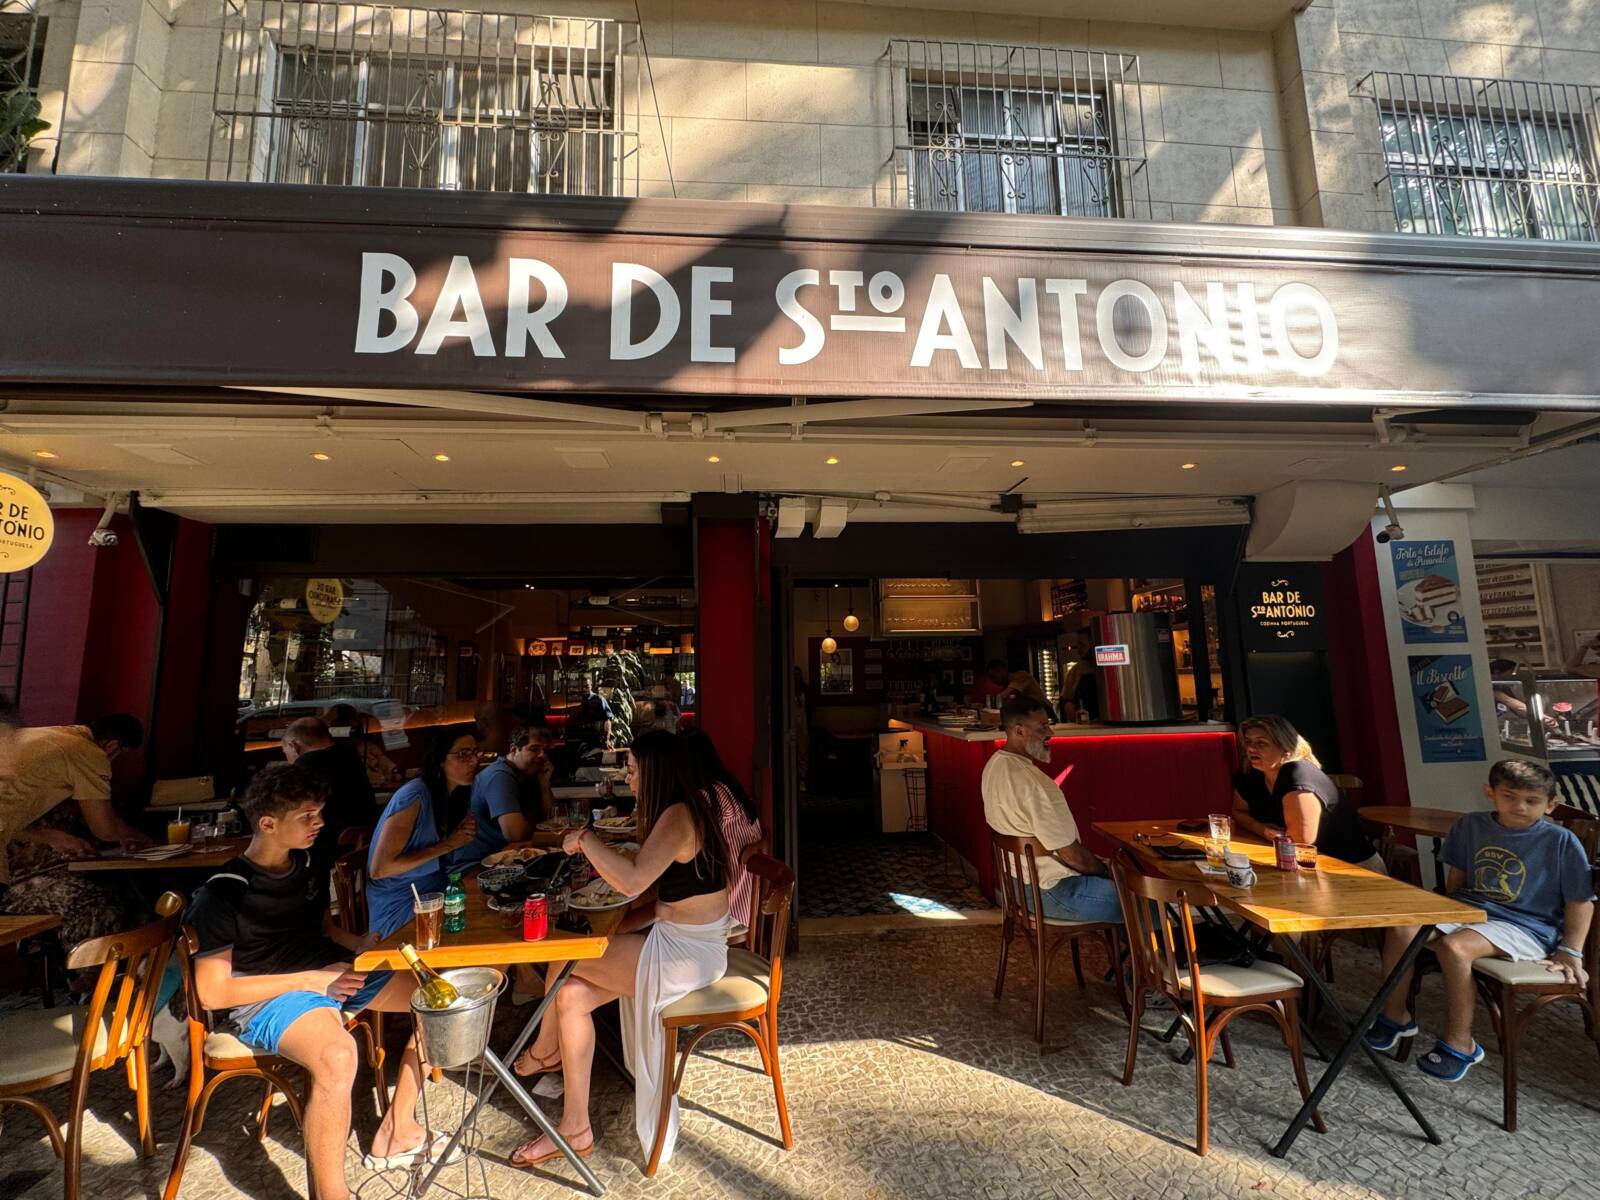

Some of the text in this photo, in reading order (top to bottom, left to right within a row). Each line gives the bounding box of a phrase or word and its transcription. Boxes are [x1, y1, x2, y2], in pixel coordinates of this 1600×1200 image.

[355, 251, 568, 359] BAR
[610, 262, 736, 363] DE
[909, 272, 1340, 378] ANTONIO
[9, 503, 29, 520] DE
[1262, 591, 1301, 604] BAR DE
